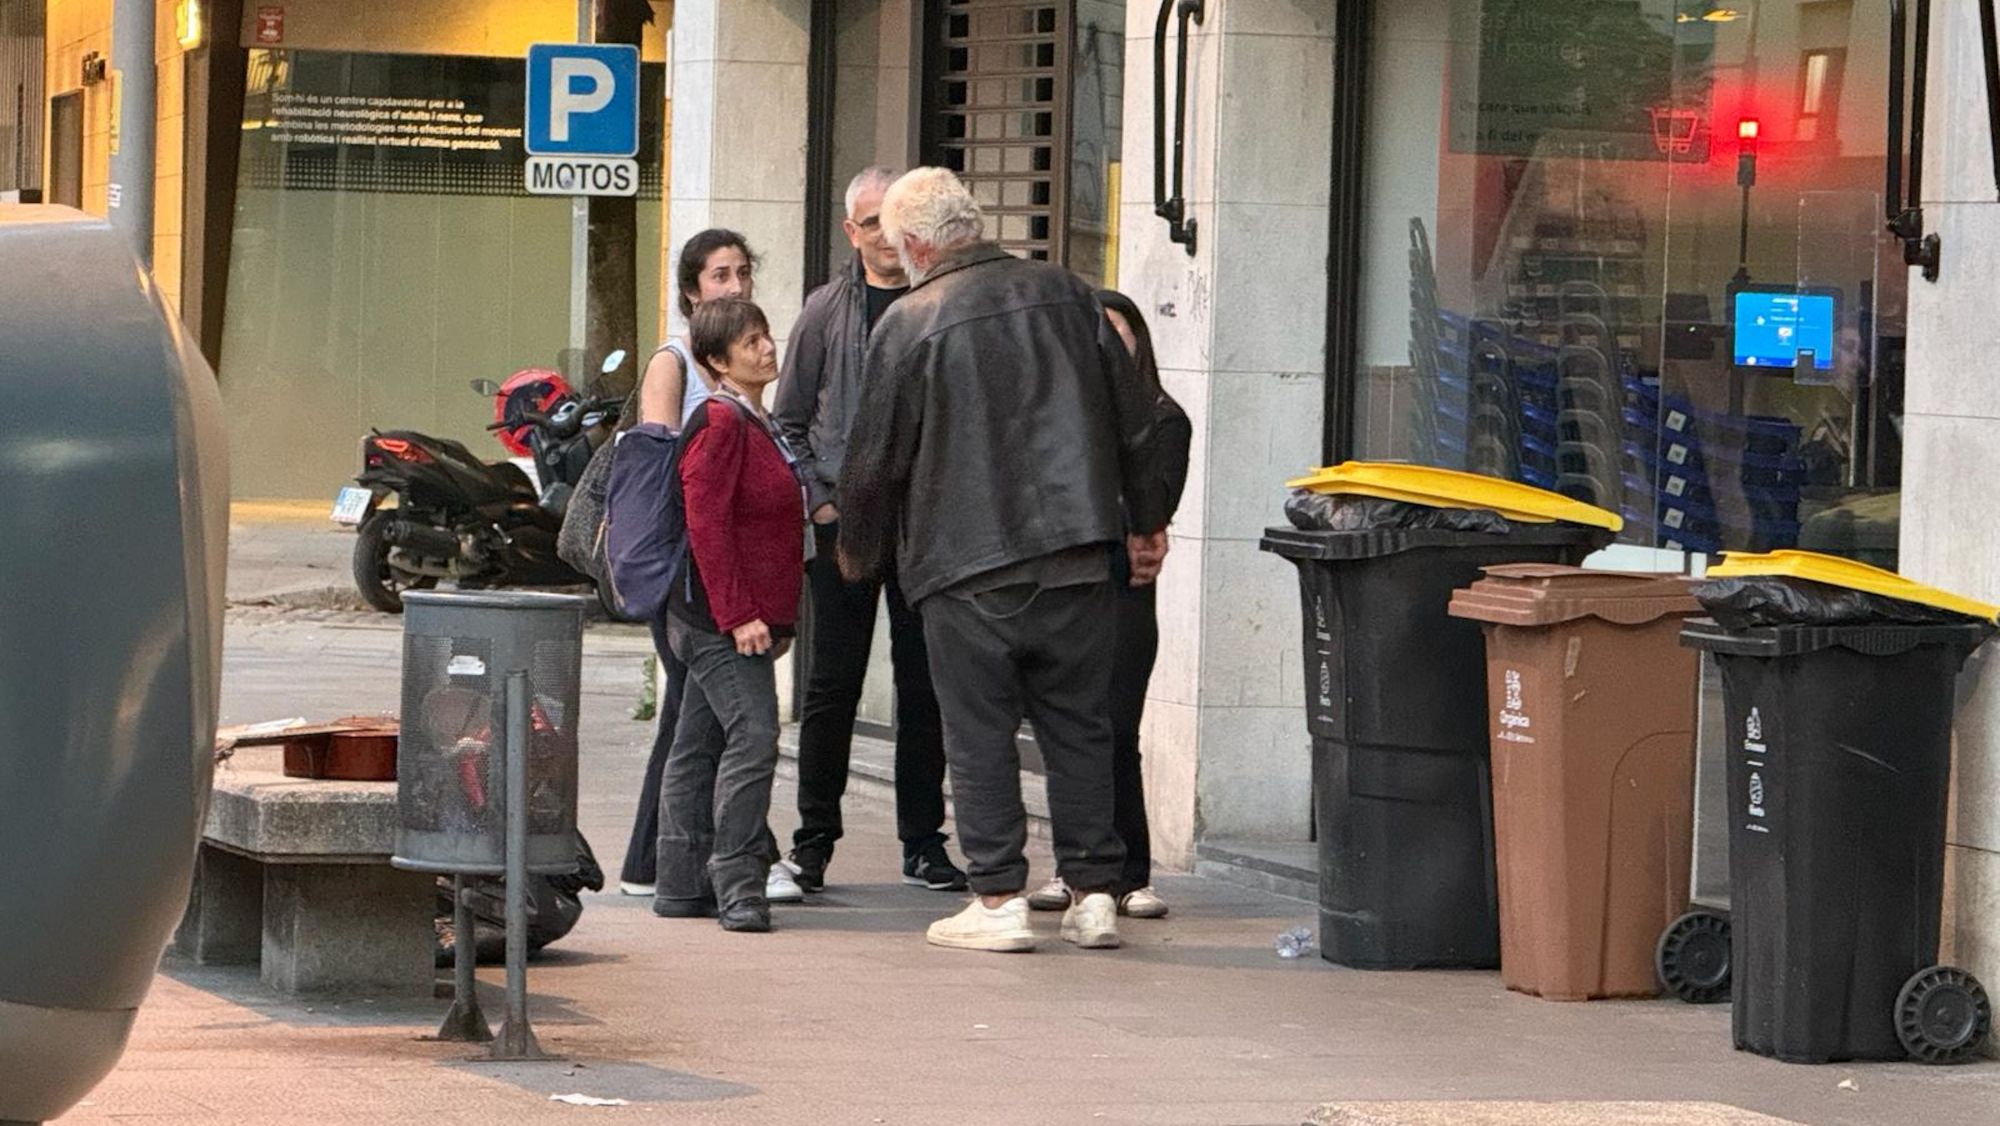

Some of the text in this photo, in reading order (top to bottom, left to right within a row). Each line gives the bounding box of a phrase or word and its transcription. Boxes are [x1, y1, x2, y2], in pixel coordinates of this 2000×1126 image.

[307, 92, 319, 104] és
[320, 95, 333, 104] un
[334, 95, 366, 106] centre
[367, 97, 427, 108] capdavanter
[428, 100, 445, 110] per
[446, 101, 454, 110] a
[455, 99, 465, 110] la
[550, 57, 616, 142] P
[271, 107, 332, 118] rehabilitació
[333, 108, 391, 121] neurològica
[463, 113, 483, 124] que
[314, 121, 329, 130] les
[330, 121, 397, 135] metodologies
[397, 124, 418, 134] més
[418, 124, 464, 136] efectives
[464, 126, 480, 136] del
[480, 128, 522, 138] moment
[270, 133, 293, 143] amb
[293, 134, 335, 144] robòtica
[341, 136, 378, 146] realitat
[378, 136, 410, 147] virtual
[410, 137, 450, 148] d'última
[532, 163, 631, 191] MOTOS
